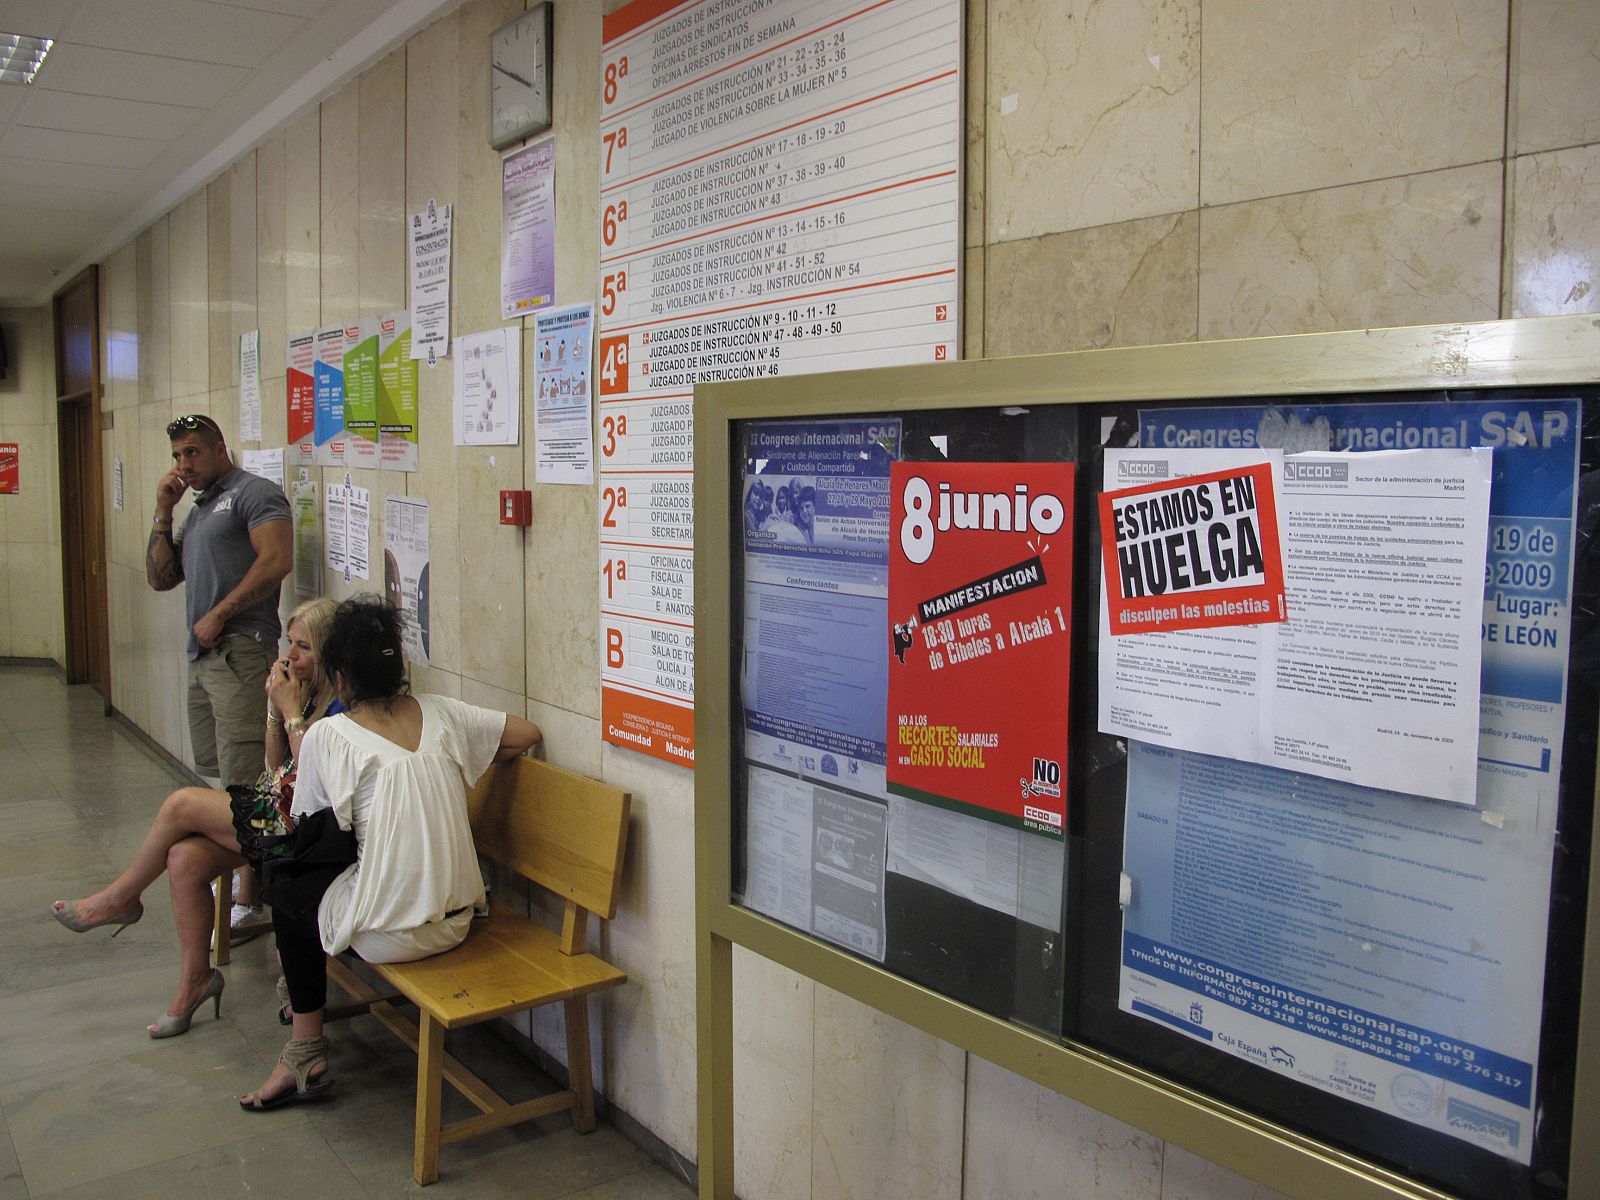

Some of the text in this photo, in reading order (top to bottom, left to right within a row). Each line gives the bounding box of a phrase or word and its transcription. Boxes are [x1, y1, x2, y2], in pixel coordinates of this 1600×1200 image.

[652, 21, 749, 74] OFICINAS DE SINDICATOS
[652, 17, 796, 88] OFICINA ARRESTOS FIN DE SEMANA
[604, 56, 628, 104] 8ª
[652, 127, 686, 150] JUZGADO
[688, 122, 698, 136] DE
[700, 106, 744, 131] VIOLENCIA
[746, 93, 776, 114] SOBRE
[778, 90, 790, 102] LA
[792, 74, 825, 97] MUJER
[841, 67, 847, 80] 5
[603, 126, 628, 174] 7ª
[602, 200, 628, 246] 6ª
[652, 250, 692, 268] JUZGADOS
[694, 244, 704, 258] DE
[706, 231, 762, 254] INSTRUCCIÓN
[778, 225, 788, 238] 13
[796, 220, 806, 232] 14
[815, 216, 825, 229] 15
[834, 212, 846, 225] 16
[602, 270, 626, 316] 5ª
[650, 303, 836, 343] JUZGADOS DE INSTRUCCIÓN Nº 9 10 11 12
[650, 321, 842, 358] JUZGADOS DE INSTRUCCIÓN Nº 47 48 49 50
[602, 341, 628, 388] 4ª
[650, 346, 780, 373] JUZGADO DE INSTRUCCIÓN Nº 45
[649, 364, 778, 388] JUZGADO DE INSTRUCCIÓN Nº 46
[650, 404, 690, 418] JUZGADOS
[602, 414, 626, 458] 3ª
[650, 420, 686, 432] JUZGADO
[1147, 426, 1155, 446] I
[1163, 425, 1259, 448] Congres
[1480, 410, 1569, 448] SAP
[787, 462, 855, 474] Custodia Compartida
[1130, 464, 1154, 474] CCOO
[1299, 466, 1331, 478] CCOO
[1389, 476, 1432, 484] administración
[1442, 477, 1464, 485] justicia
[1444, 484, 1464, 492] Madrid
[602, 486, 626, 528] 2ª
[651, 511, 680, 523] OFICINA
[900, 476, 1065, 564] 8 junio
[1113, 476, 1255, 542] ESTAMOS EN
[1495, 528, 1554, 553] 19 de
[650, 556, 680, 569] OFICINA
[1118, 516, 1264, 598] HUELGA
[602, 559, 626, 598] 1ª
[651, 571, 684, 584] FISCALIA
[786, 576, 838, 590] Conferenciantes
[1500, 562, 1552, 587] 2009
[652, 586, 682, 600] SALA DE
[922, 565, 1038, 618] MANIFESTACION
[1120, 598, 1270, 624] disculpen las molestias
[1496, 594, 1558, 620] Lugar:
[651, 630, 679, 644] MEDICO
[922, 612, 992, 649] 18:30 horas
[929, 606, 1066, 671] de Cibeles a Alcalá 1
[1505, 620, 1557, 648] LEÓN
[607, 628, 624, 669] B
[652, 644, 682, 660] SALA DE
[898, 715, 928, 726] NO A LOS
[609, 724, 694, 760] Comunidad Madrid
[898, 726, 998, 748] RECORTES SALARIALES
[1512, 732, 1549, 744] Sanitario
[898, 756, 904, 764] NI
[910, 746, 944, 767] GASTO
[947, 746, 986, 768] SOCIAL
[1034, 758, 1060, 784] NO
[1024, 818, 1062, 836] área pública
[1026, 808, 1050, 820] CCOO
[1153, 946, 1475, 1062] www.congresointernacionalsap.org
[1130, 948, 1522, 1088] TFNOS DE INFORMACIÓN: 655 440 560 639 218 289 987 276 317
[1204, 984, 1411, 1062] Fax: 987 276 318 www.sospapa.es
[1218, 1032, 1268, 1058] Caja España
